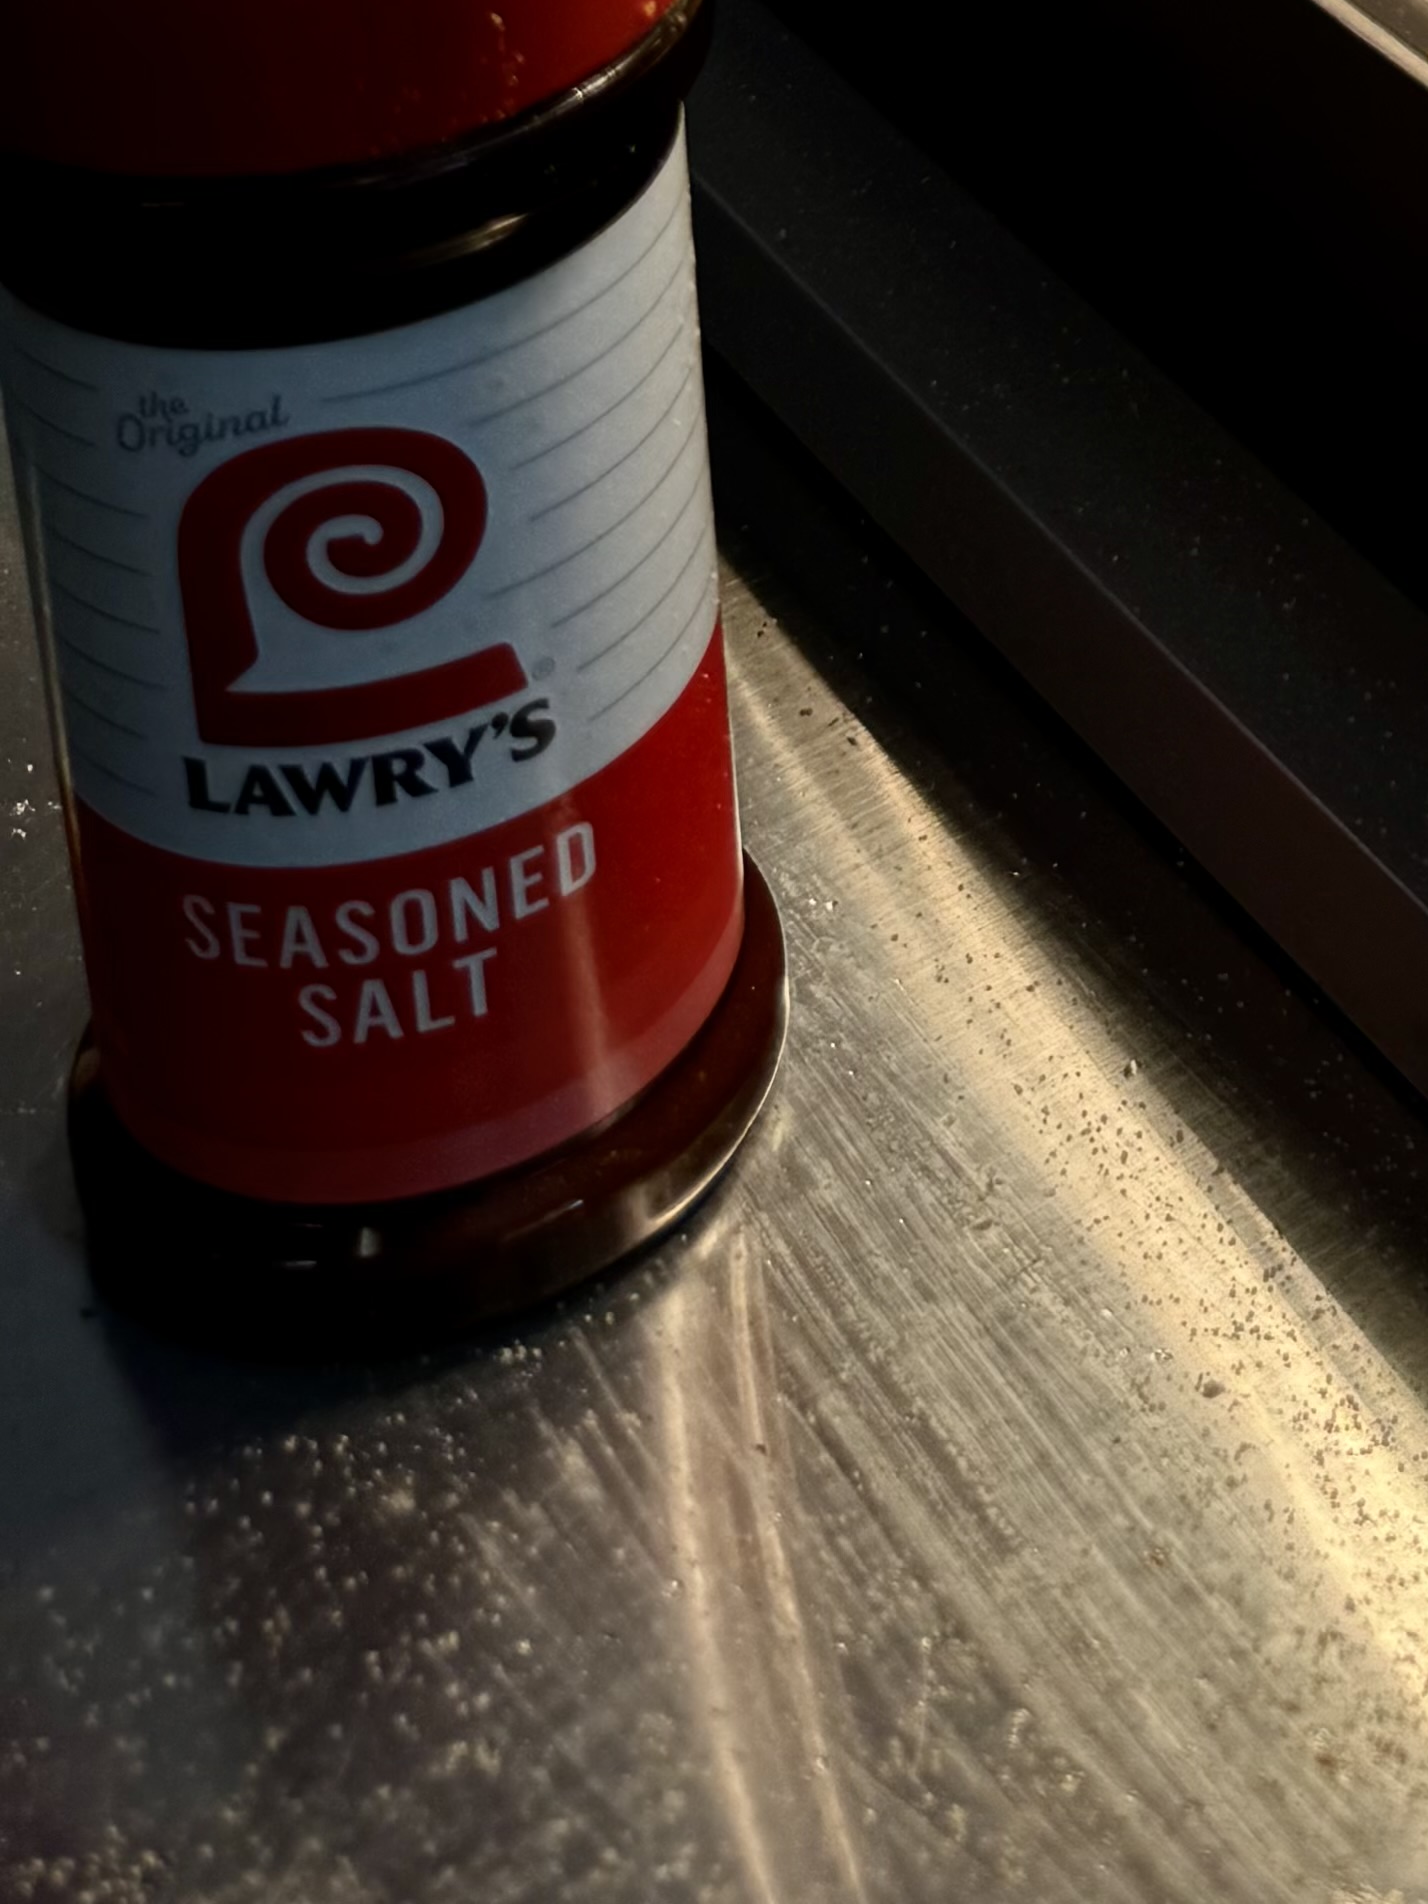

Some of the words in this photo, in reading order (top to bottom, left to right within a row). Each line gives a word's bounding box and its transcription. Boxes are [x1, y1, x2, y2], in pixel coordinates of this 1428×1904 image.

[116, 393, 291, 458] Original
[138, 391, 191, 424] the
[181, 697, 557, 818] LAWRY'S
[181, 820, 598, 970] SEASONED
[298, 947, 498, 1048] SALT
